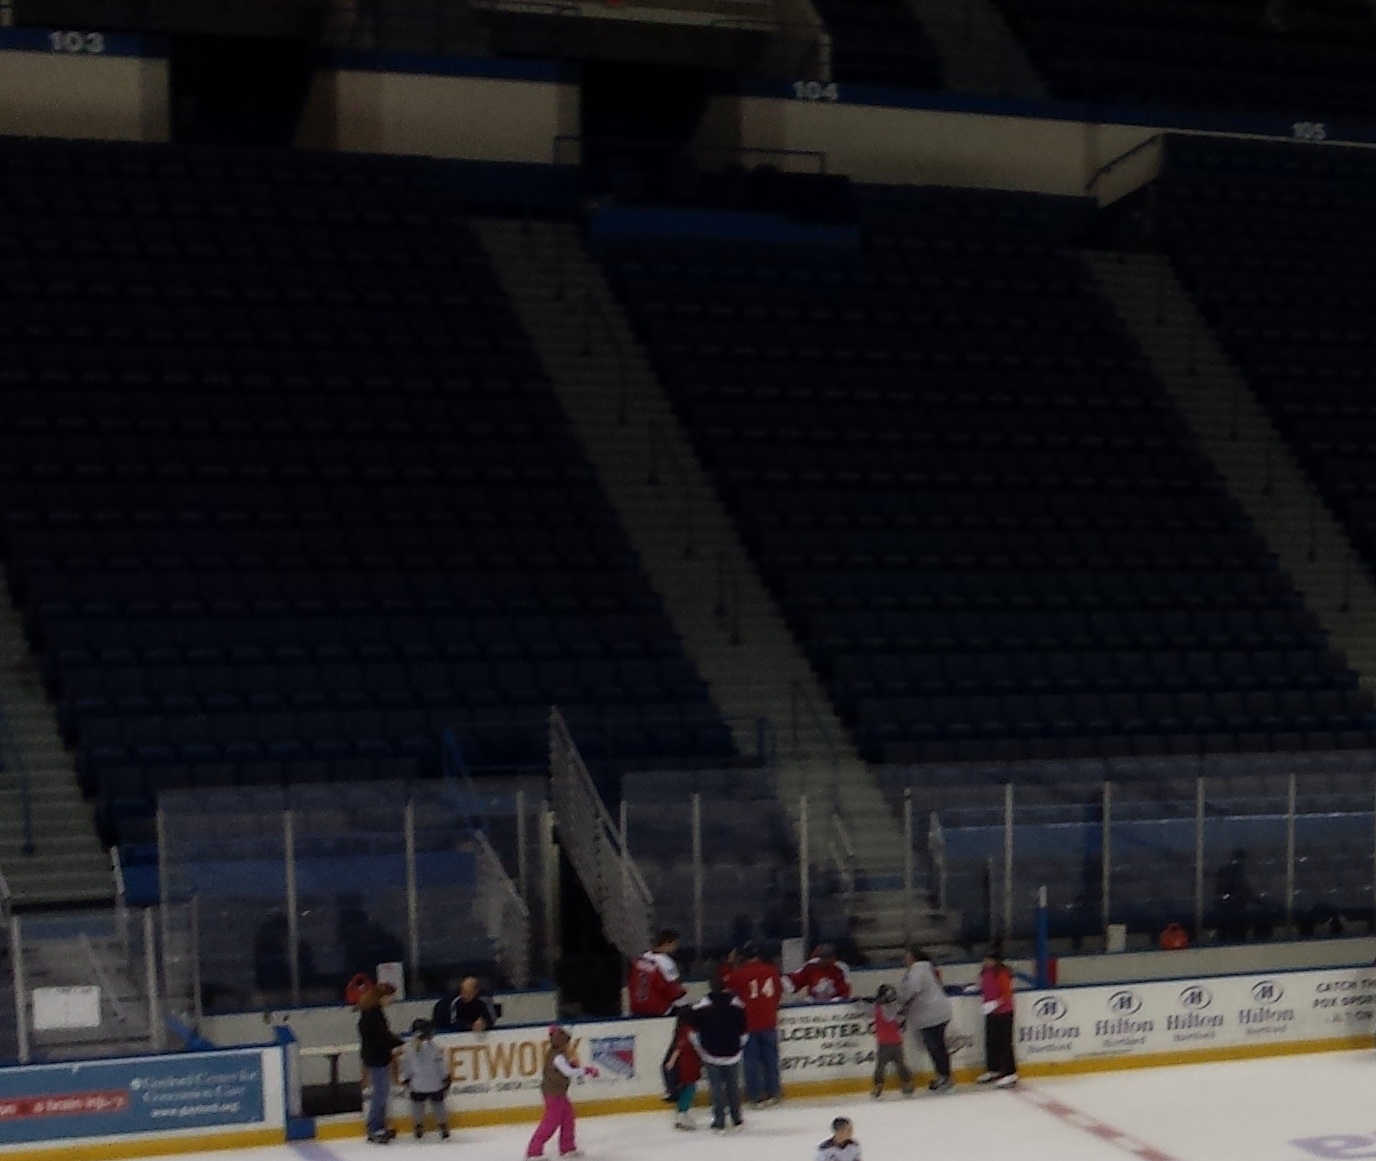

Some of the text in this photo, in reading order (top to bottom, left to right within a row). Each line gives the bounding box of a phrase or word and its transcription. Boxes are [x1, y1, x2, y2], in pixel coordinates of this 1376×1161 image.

[49, 31, 105, 55] 103
[792, 80, 840, 102] 104
[749, 975, 777, 1000] 14
[1166, 1012, 1225, 1032] Hilton
[1238, 1006, 1295, 1025] Hilton
[1018, 1023, 1081, 1042] Hilton
[1094, 1018, 1154, 1037] Hilton
